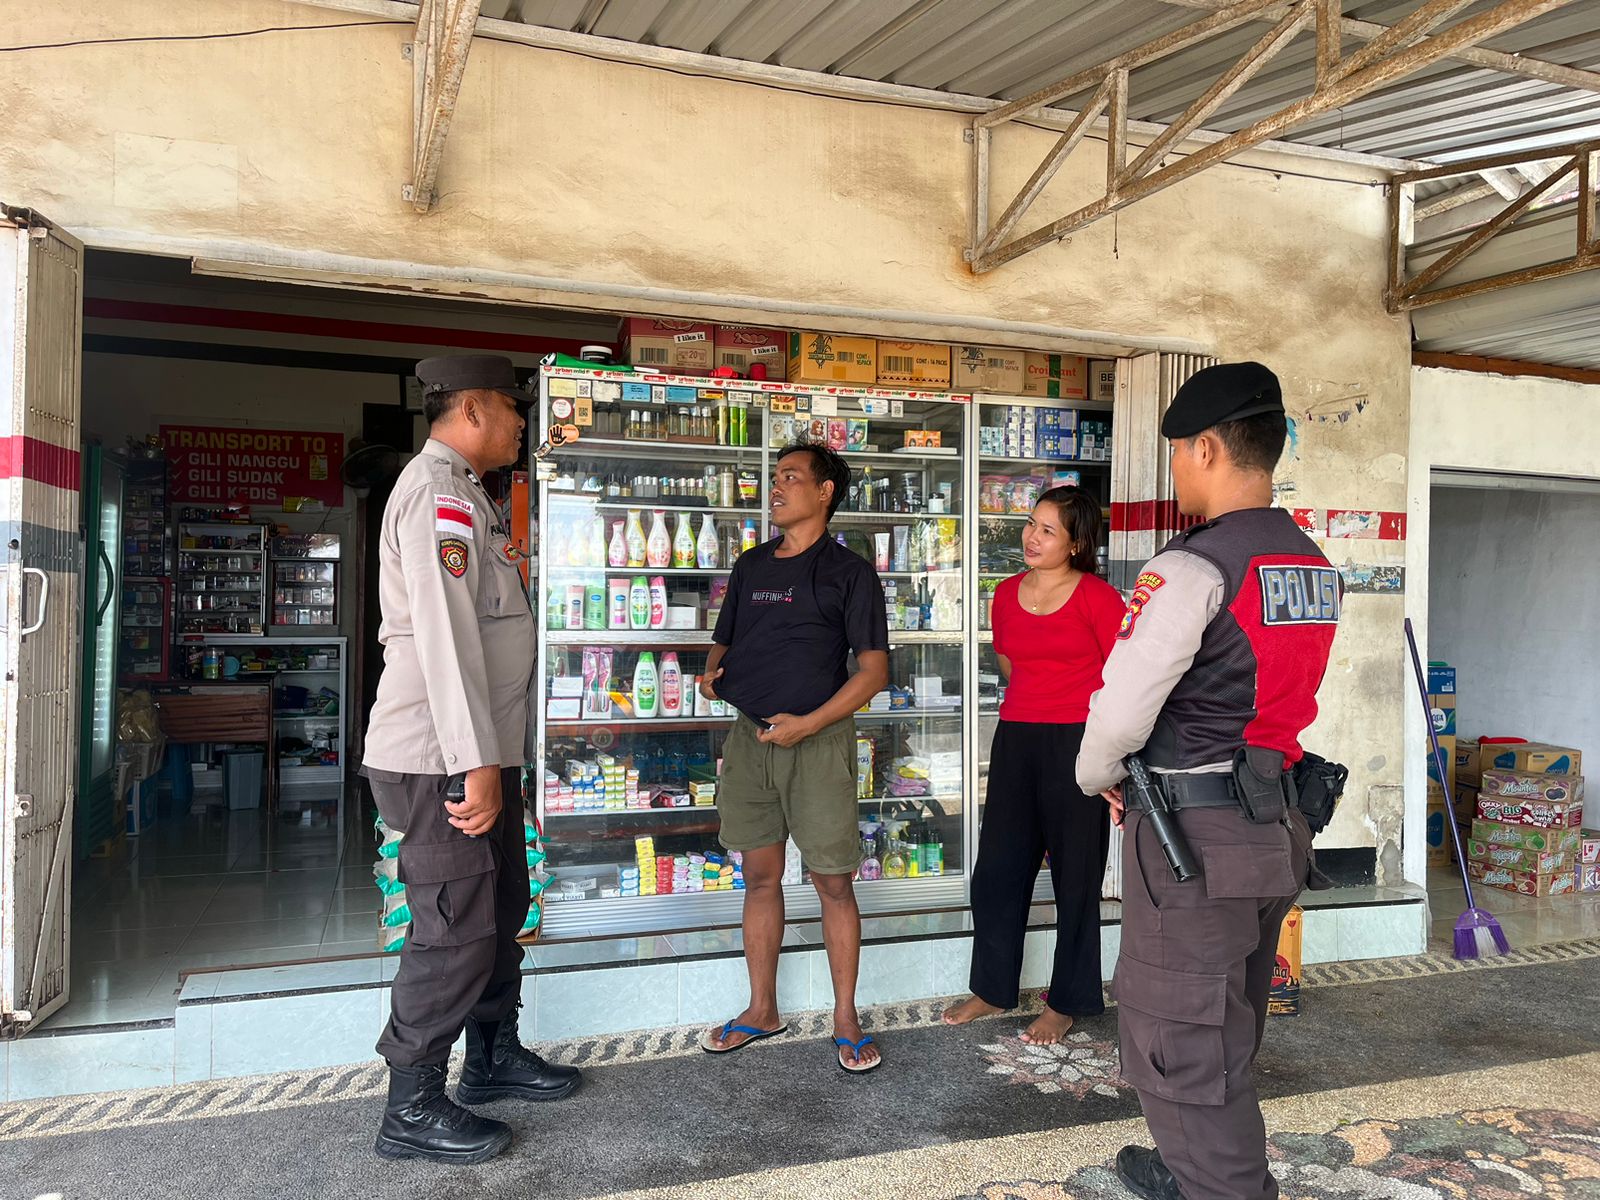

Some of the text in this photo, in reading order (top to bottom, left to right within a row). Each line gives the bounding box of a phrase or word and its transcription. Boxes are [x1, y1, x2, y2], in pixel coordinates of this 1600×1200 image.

[697, 332, 704, 340] it
[688, 350, 697, 359] 20
[1028, 364, 1077, 377] Croiant
[167, 430, 293, 451] TRANSPORT
[301, 436, 326, 452] TO
[188, 452, 300, 469] GILI NANGGU
[188, 469, 284, 484] GILI SUDAK
[188, 485, 221, 499] GILI
[437, 496, 471, 511] INDONESIA
[1266, 569, 1337, 620] POLISI
[1500, 780, 1538, 795] Mountea
[1503, 805, 1521, 815] BIG
